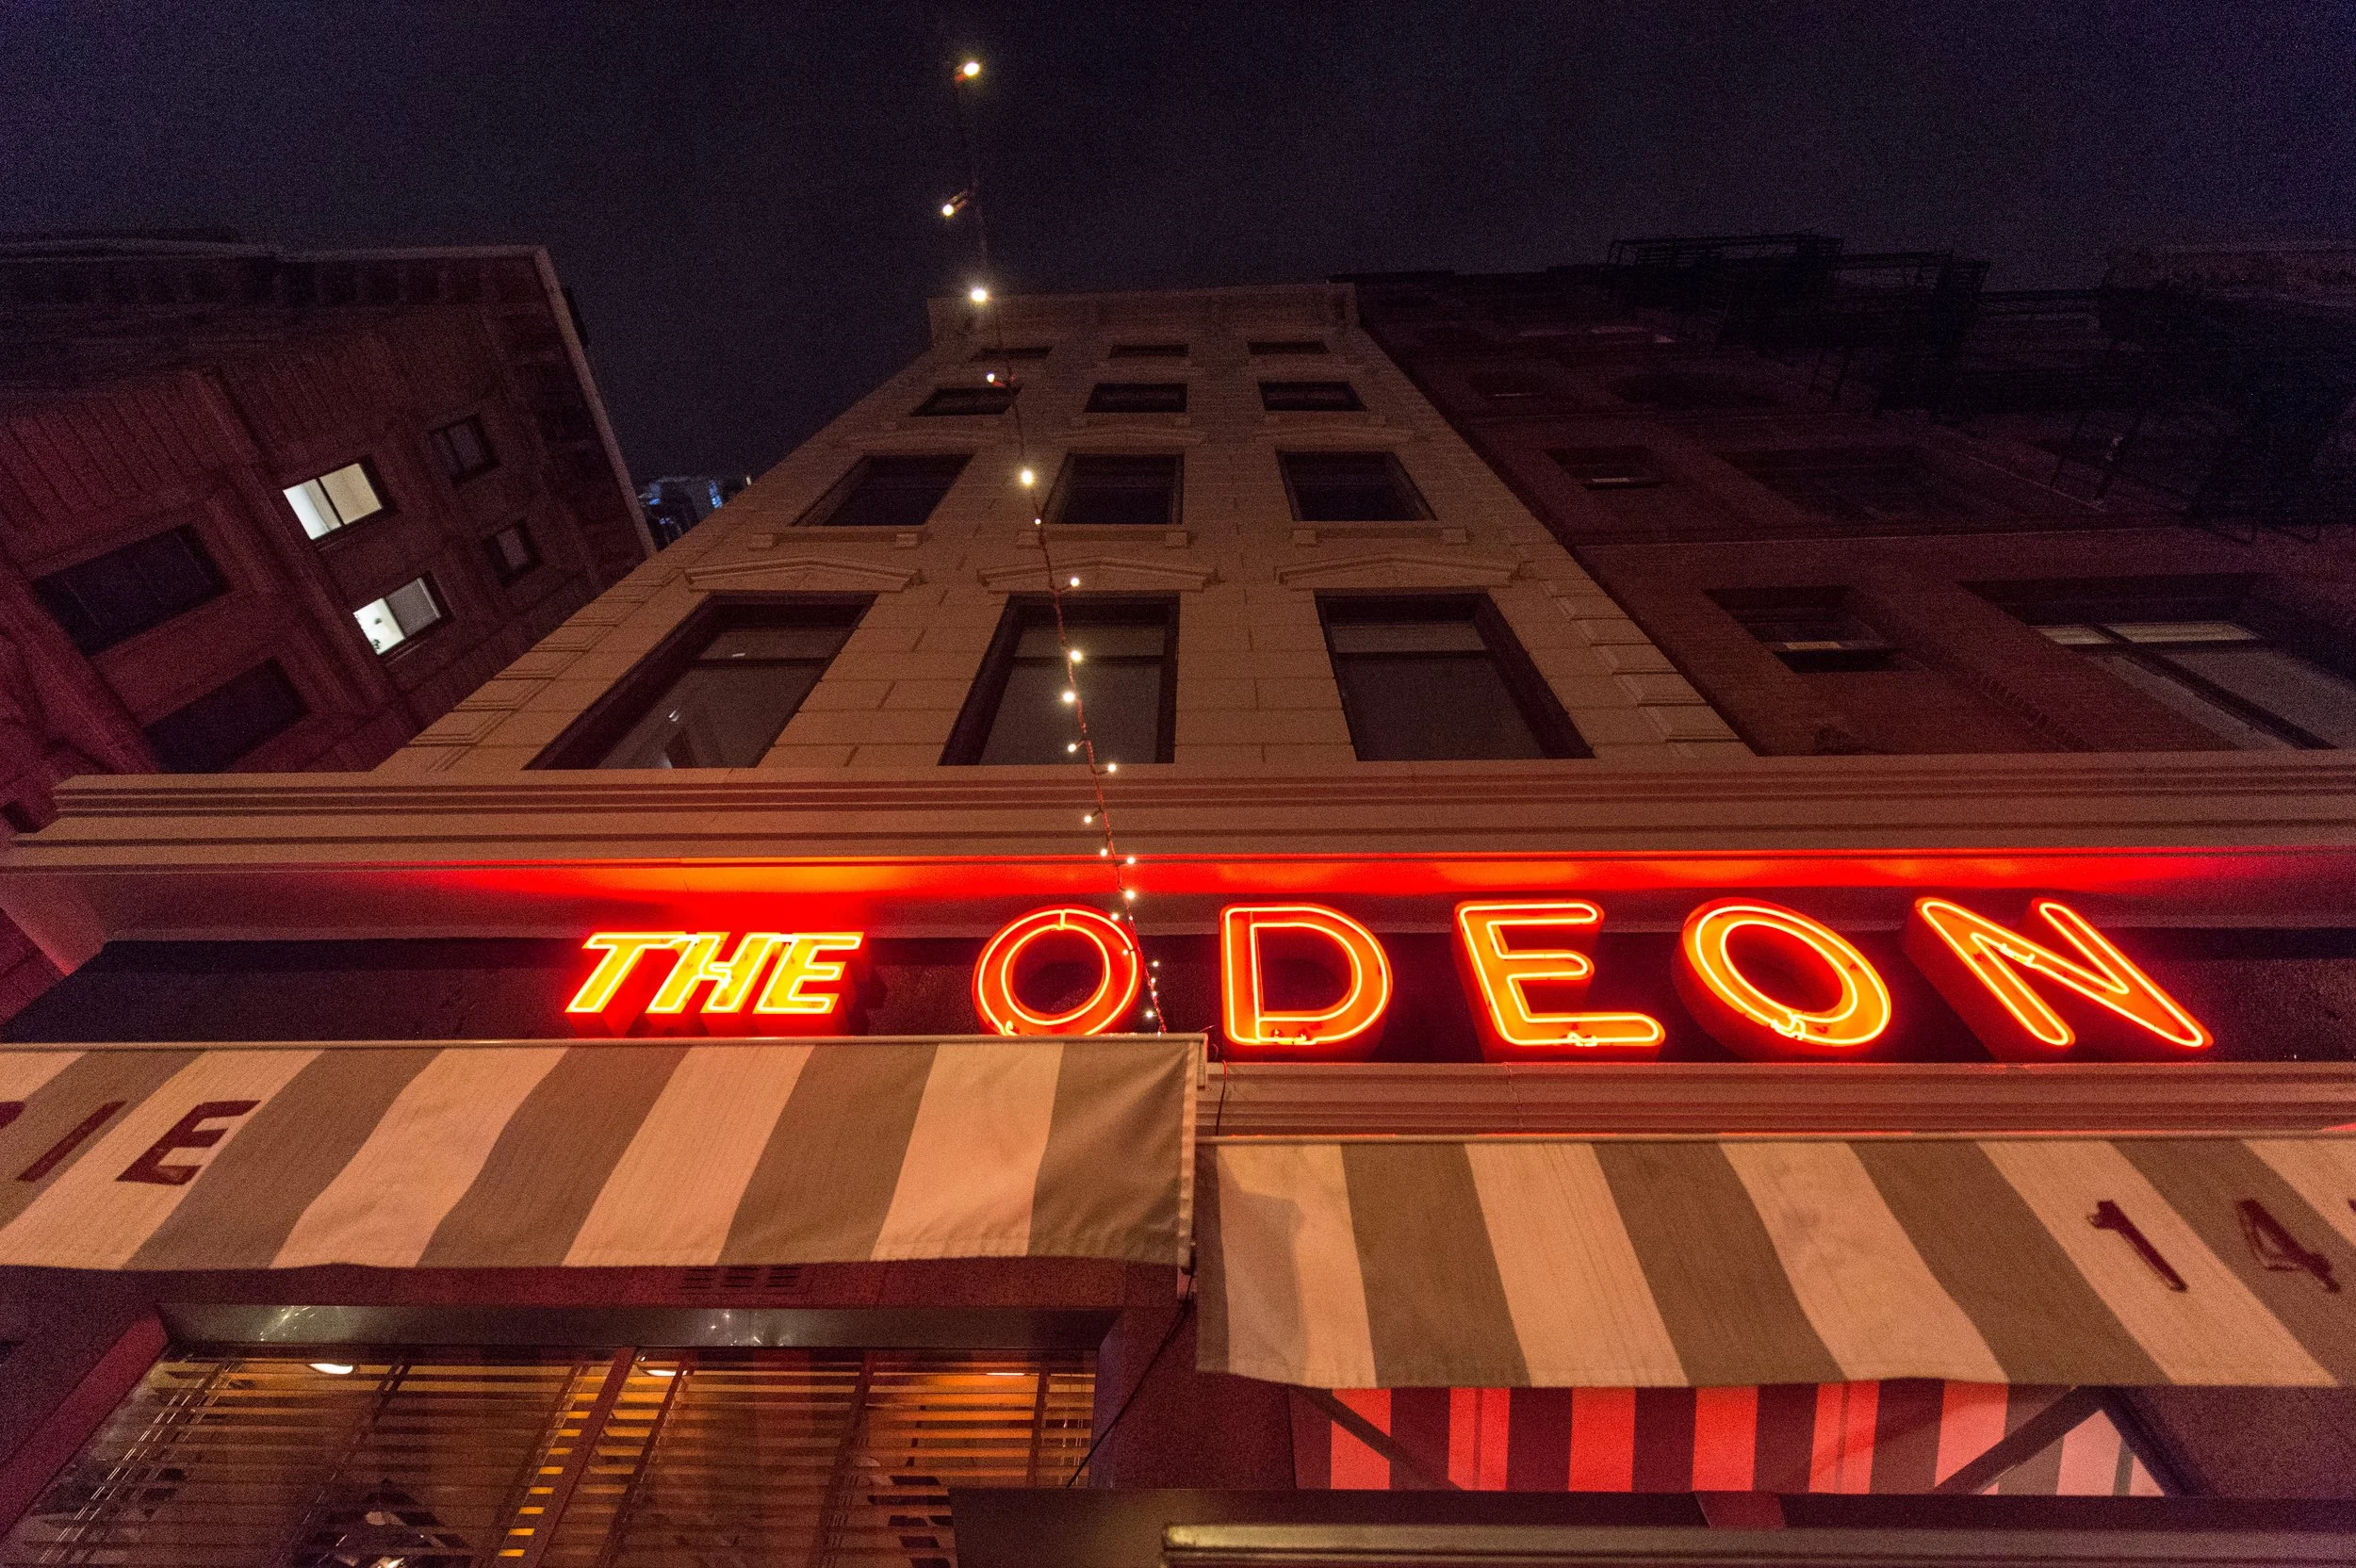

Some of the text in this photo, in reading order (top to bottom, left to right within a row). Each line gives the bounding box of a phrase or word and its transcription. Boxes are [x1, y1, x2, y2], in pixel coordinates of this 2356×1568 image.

[565, 897, 2214, 1048] THE ODEON
[0, 1100, 261, 1185] IE
[2086, 1198, 2356, 1295] 14
